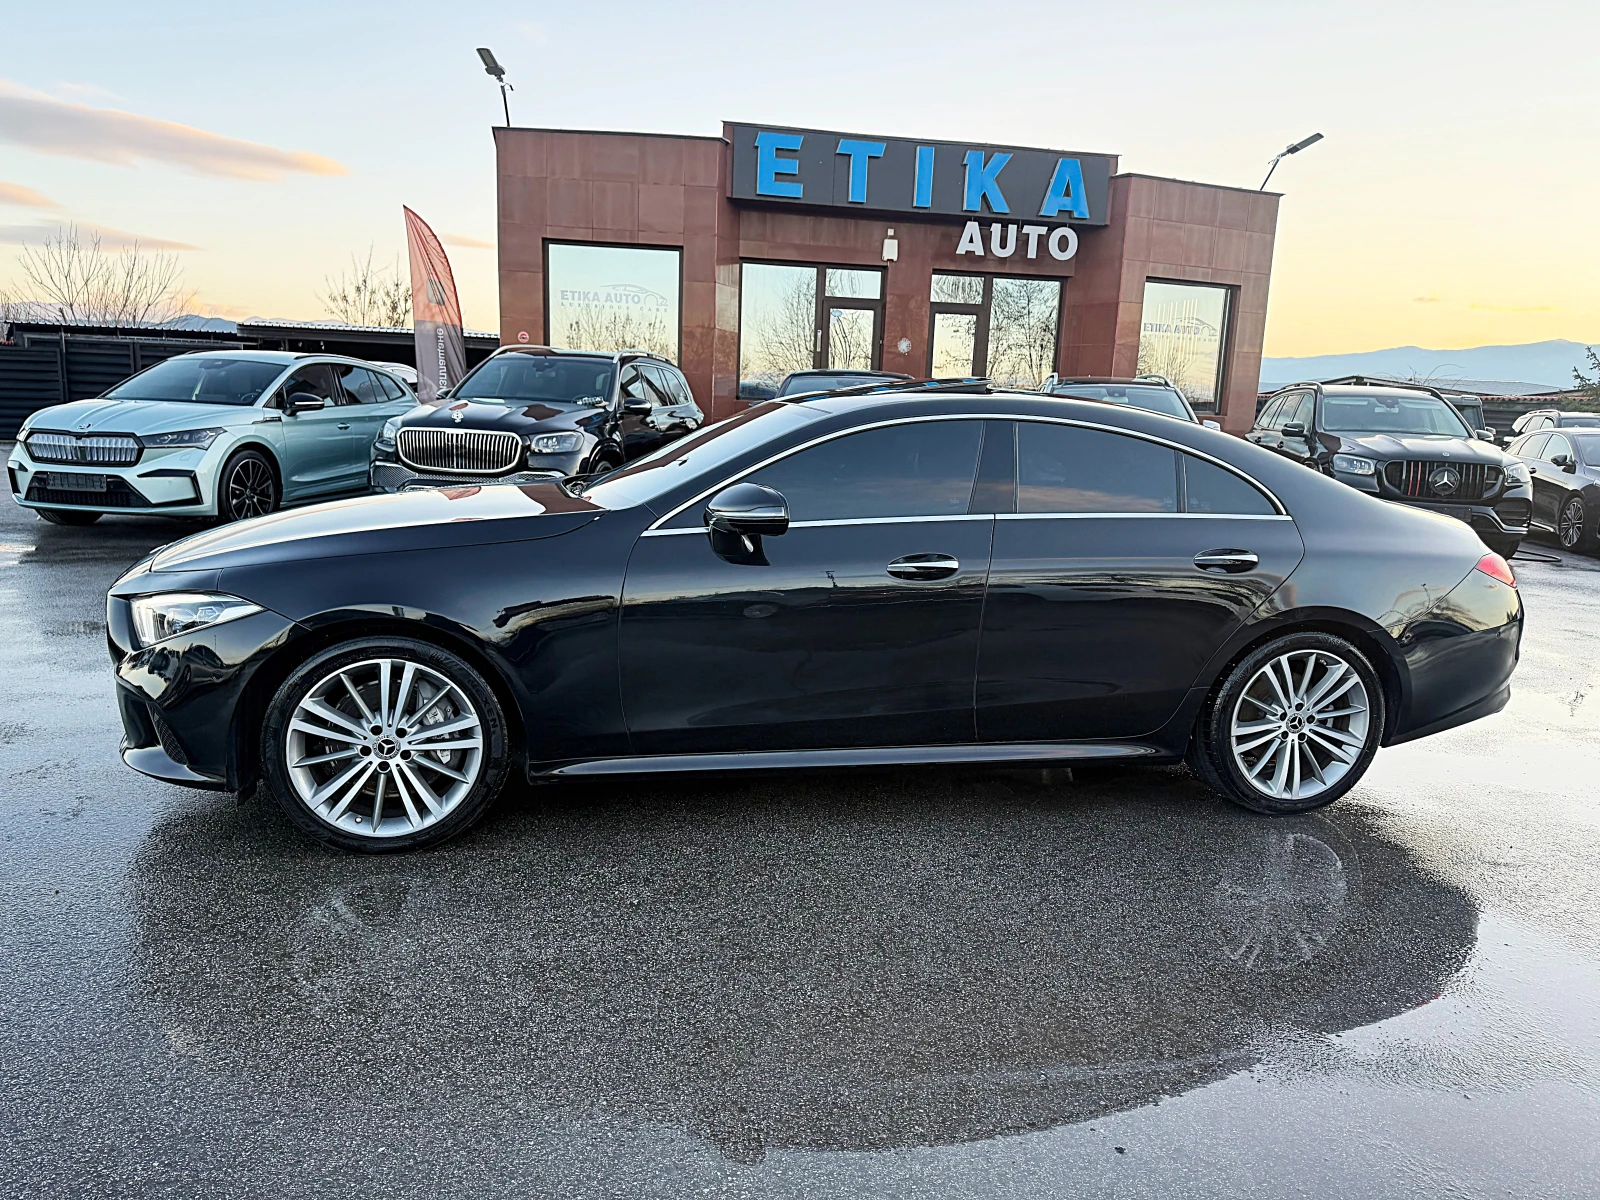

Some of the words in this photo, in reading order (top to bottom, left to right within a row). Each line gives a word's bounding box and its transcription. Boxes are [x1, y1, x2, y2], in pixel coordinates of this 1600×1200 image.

[754, 131, 1090, 219] ETIKA
[956, 221, 1079, 261] AUTO
[560, 290, 600, 302] ETIKA
[605, 293, 640, 304] AUTO
[560, 302, 630, 310] LUXURIOUS
[1143, 323, 1171, 333] ETIKA
[1174, 325, 1200, 335] AUTO
